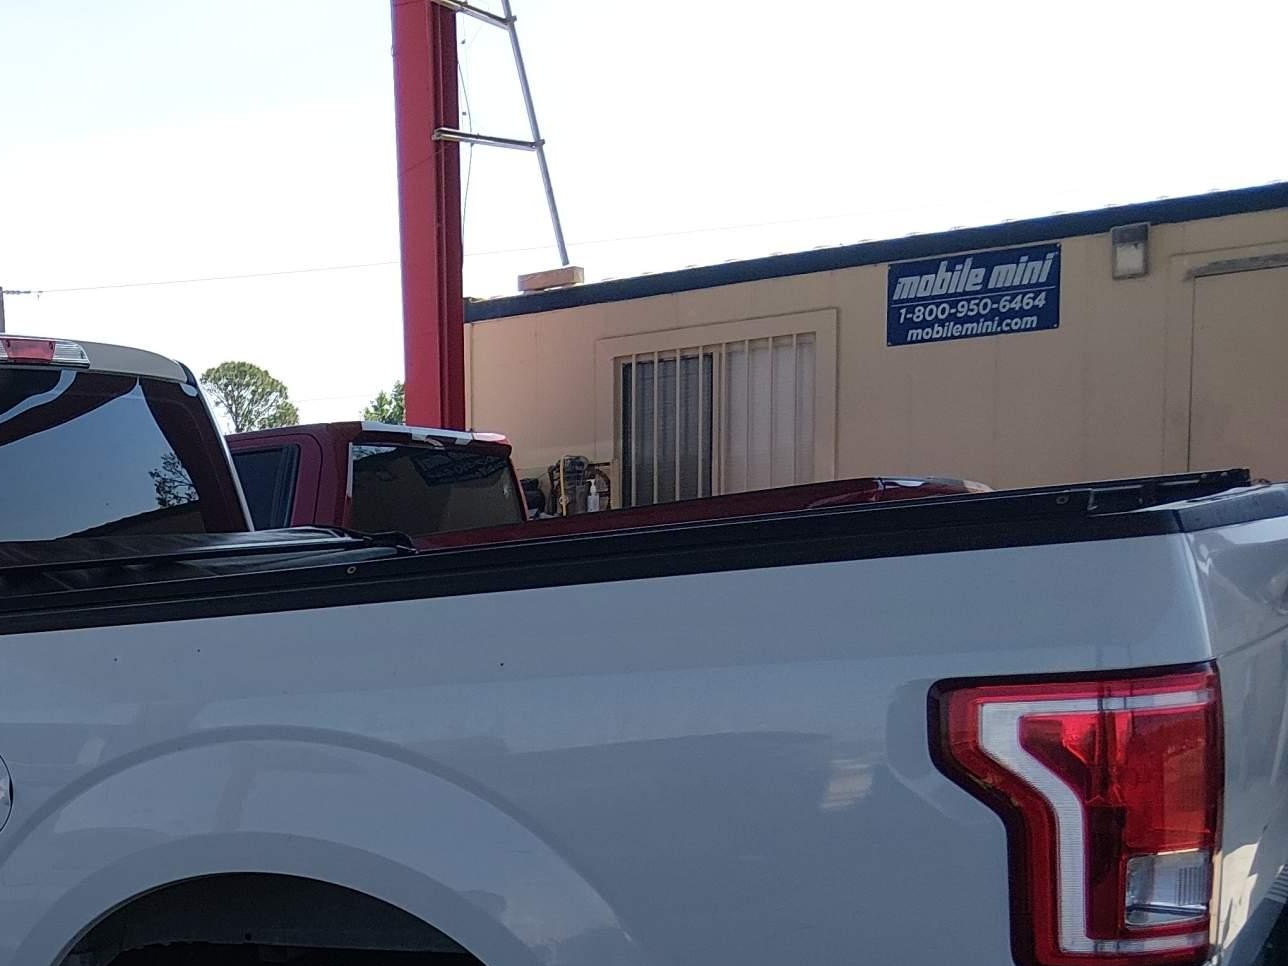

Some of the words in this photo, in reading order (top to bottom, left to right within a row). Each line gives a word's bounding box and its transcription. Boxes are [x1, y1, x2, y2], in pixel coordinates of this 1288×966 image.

[893, 257, 986, 300] mobile
[988, 252, 1055, 289] mini
[899, 291, 1047, 323] 1-800-950-6464
[906, 315, 1038, 341] mobilemini.com
